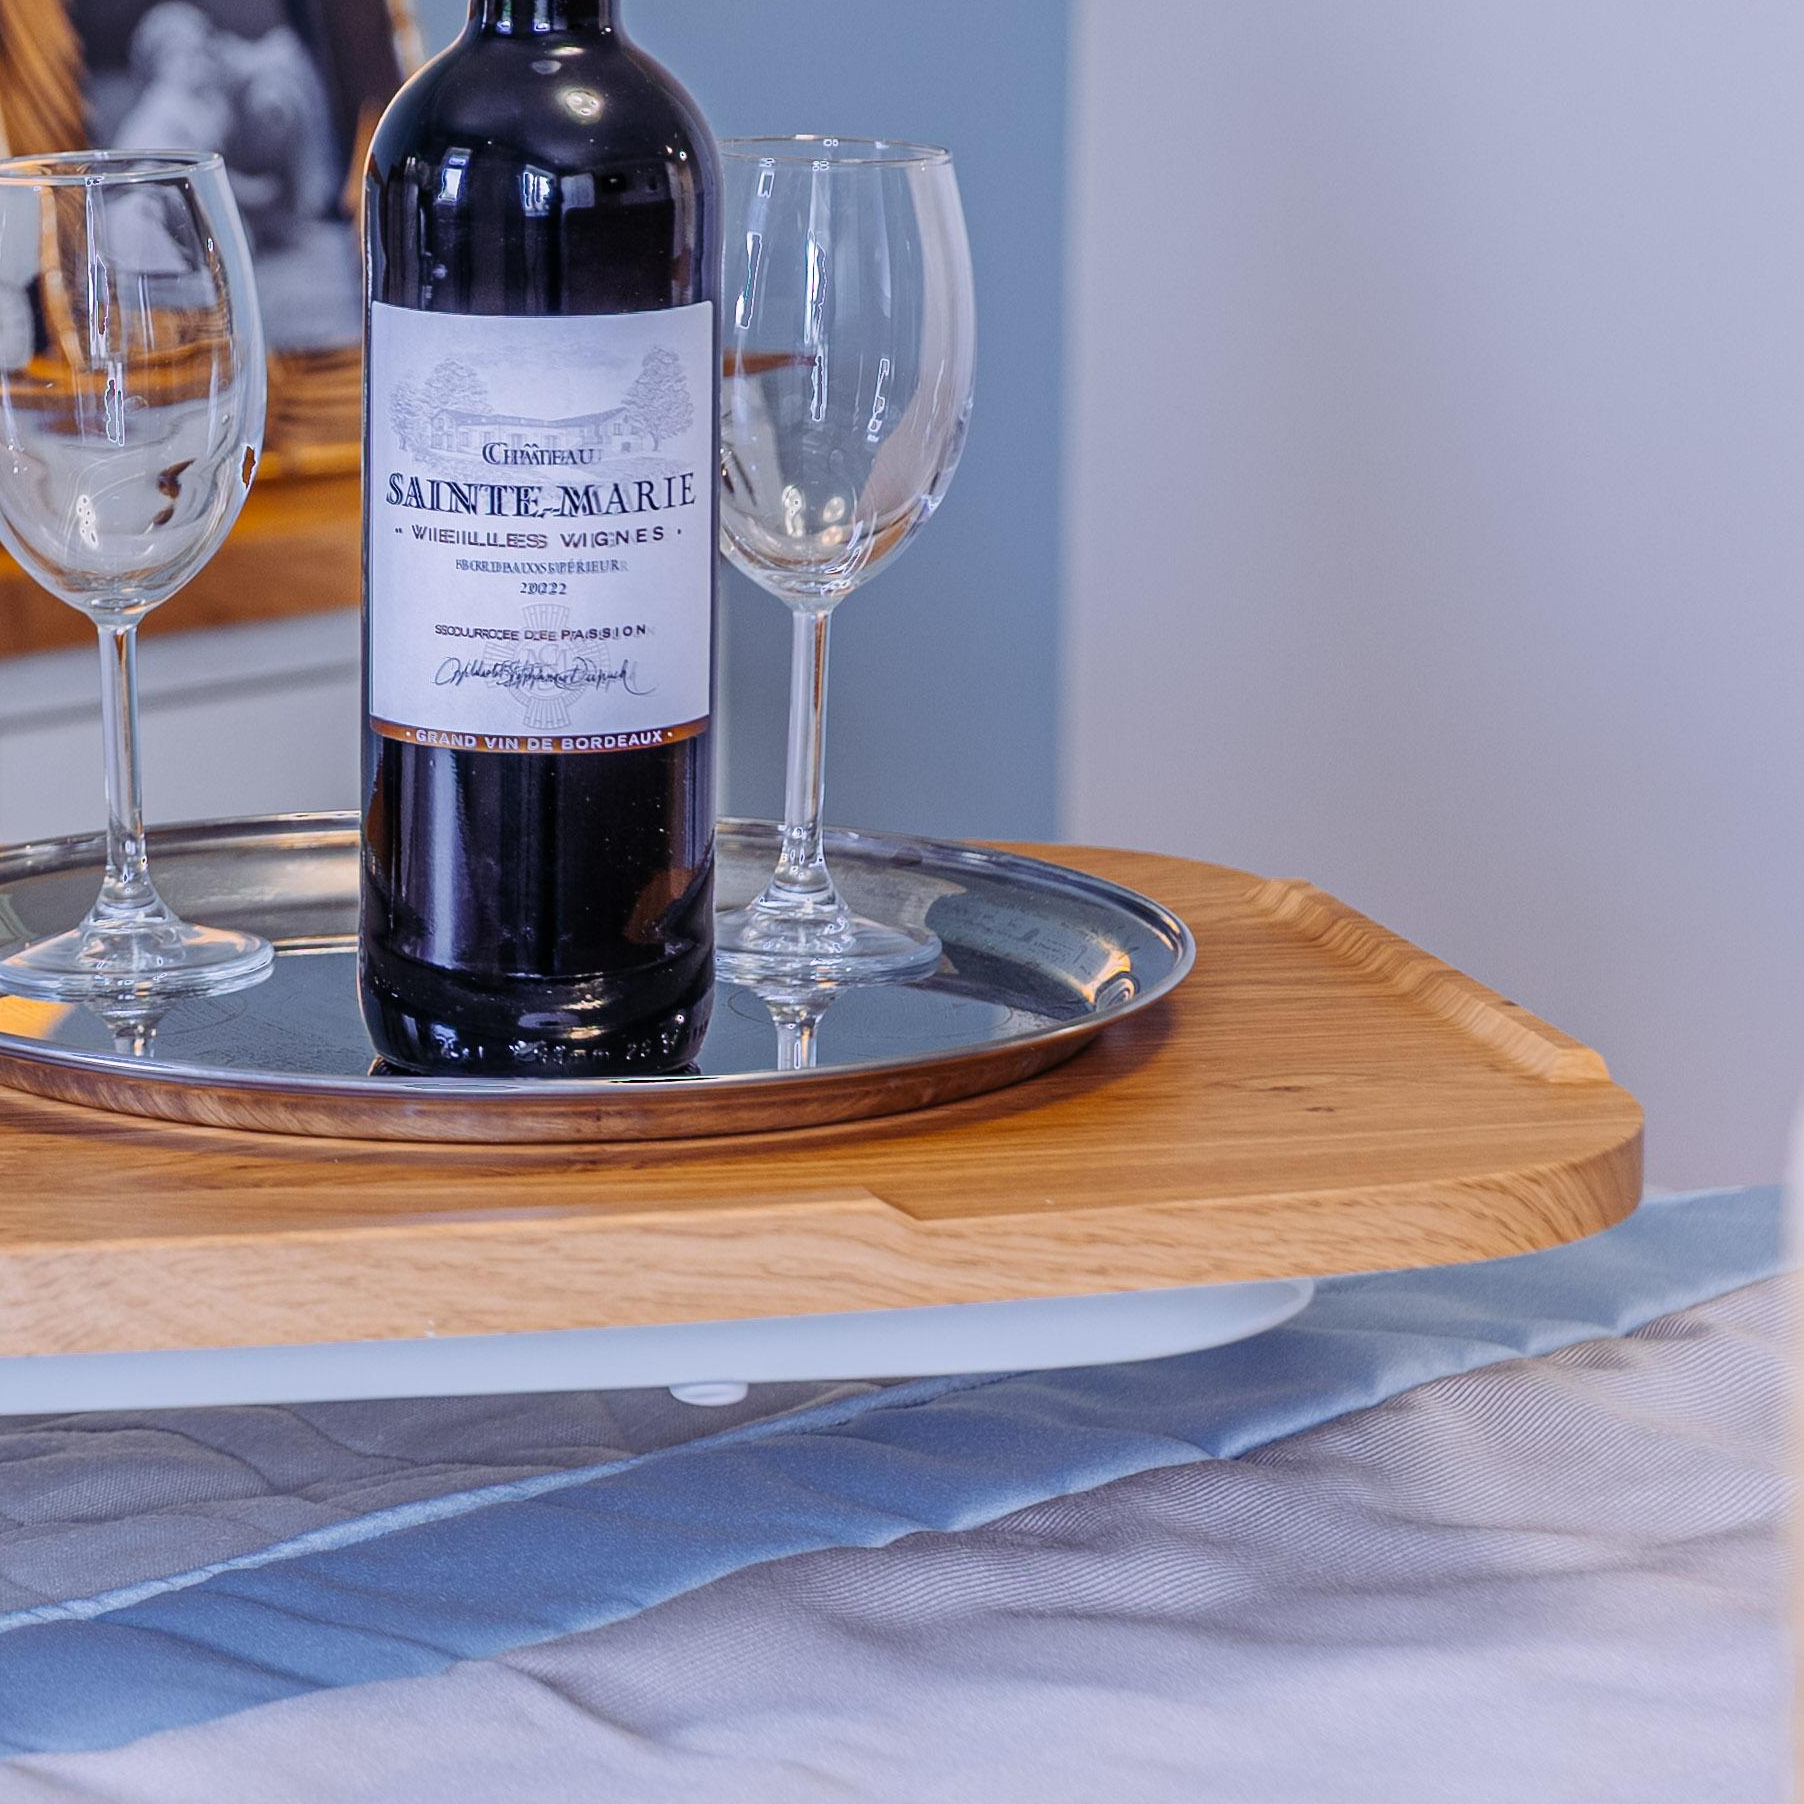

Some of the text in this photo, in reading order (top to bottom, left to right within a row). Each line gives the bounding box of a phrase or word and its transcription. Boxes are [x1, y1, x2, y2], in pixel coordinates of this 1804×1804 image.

[385, 471, 697, 518] SAINTE-MARIE
[415, 729, 664, 752] GRAND VIN DE BORDEAUX
